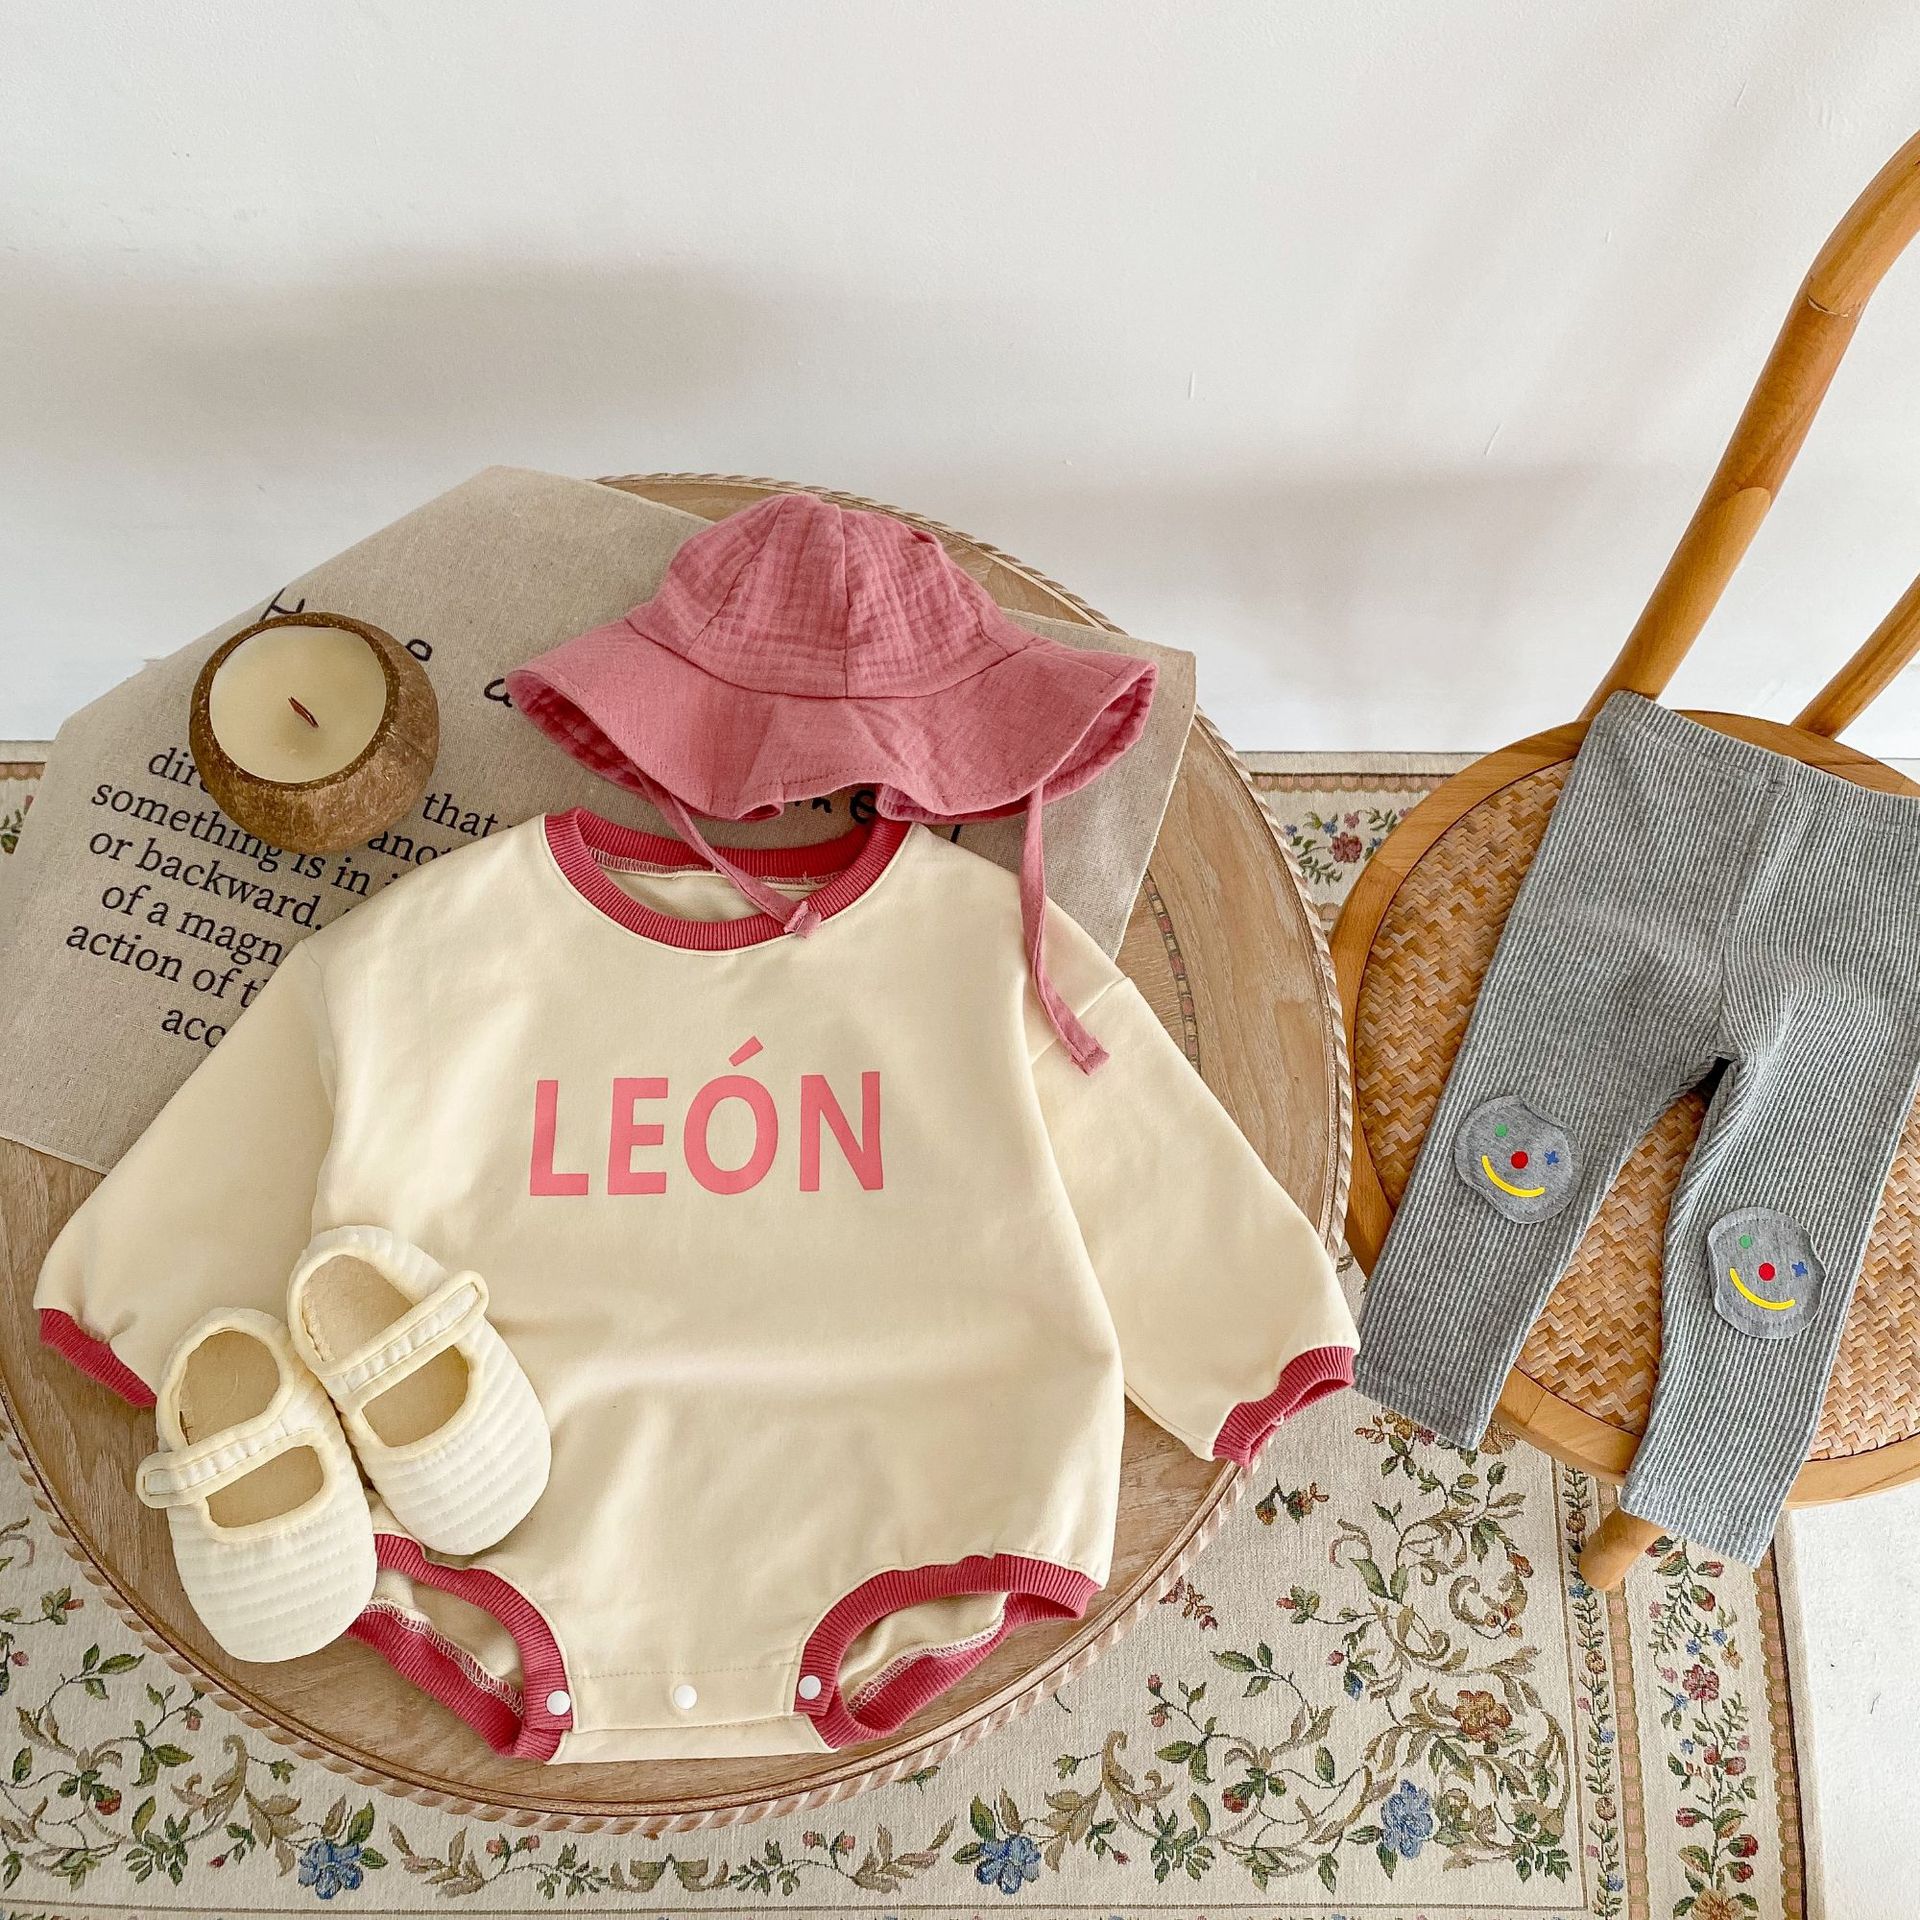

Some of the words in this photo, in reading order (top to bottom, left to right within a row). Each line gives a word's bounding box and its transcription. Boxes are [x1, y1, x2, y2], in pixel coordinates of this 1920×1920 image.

[148, 747, 209, 793] dir
[91, 783, 283, 873] something
[291, 852, 326, 879] is
[331, 856, 371, 896] in
[422, 793, 499, 838] that
[89, 832, 133, 861] or
[135, 838, 322, 931] backward.
[101, 884, 151, 916] of
[146, 901, 169, 927] a
[66, 925, 183, 983] action
[192, 967, 242, 999] of
[529, 1035, 884, 1196] LEÓN
